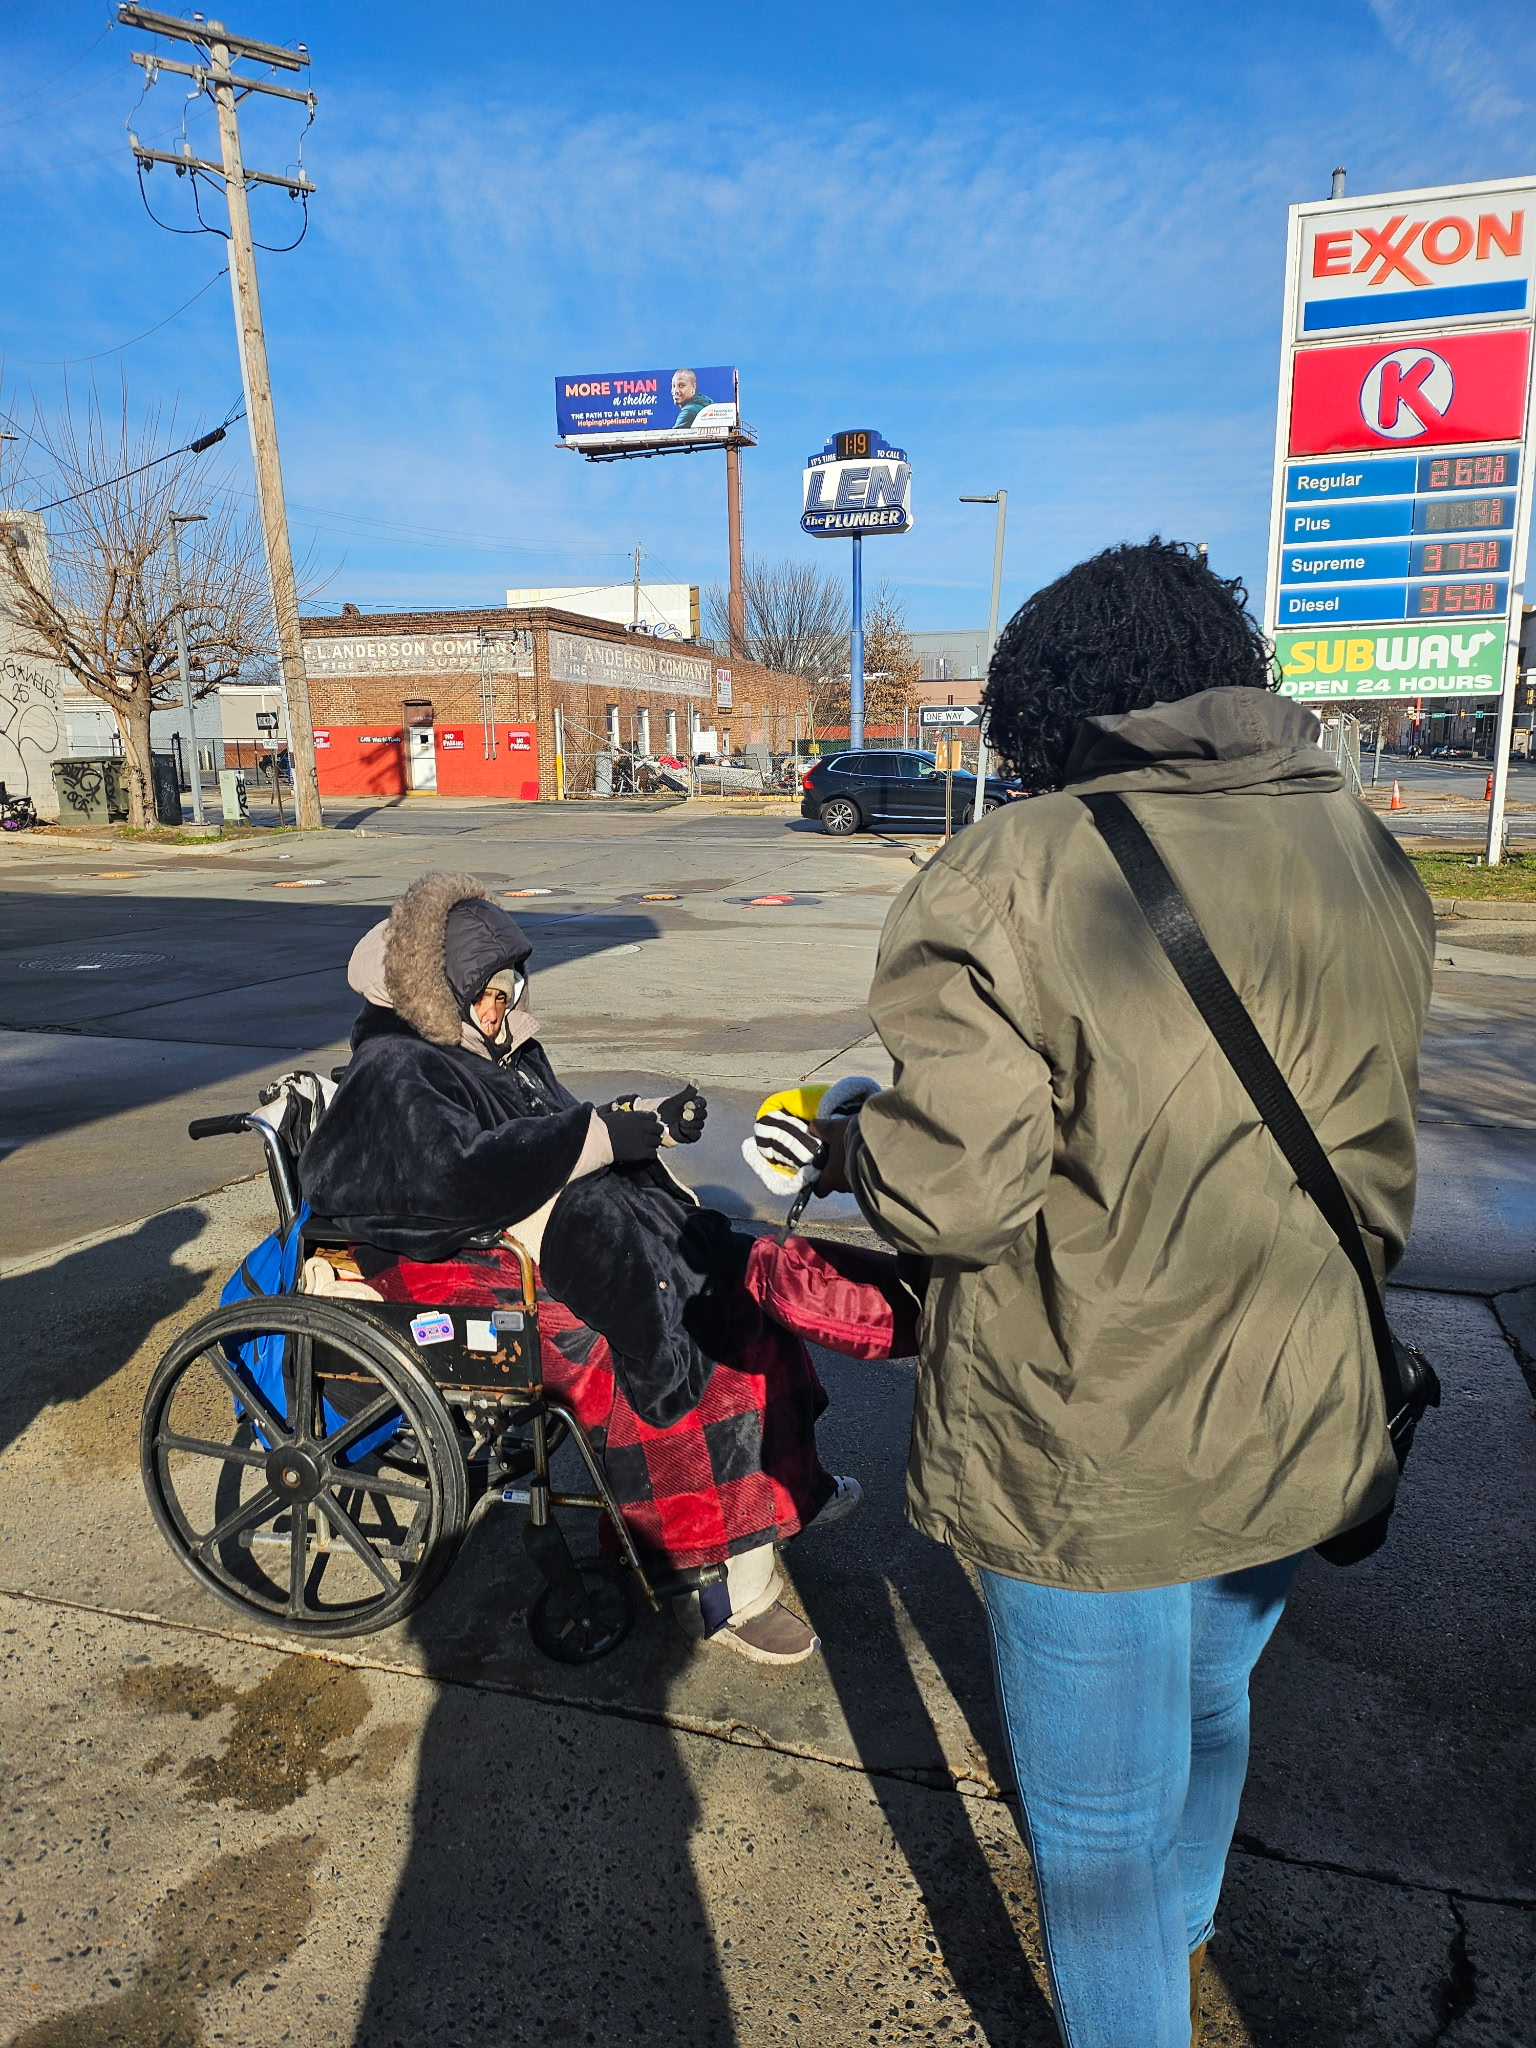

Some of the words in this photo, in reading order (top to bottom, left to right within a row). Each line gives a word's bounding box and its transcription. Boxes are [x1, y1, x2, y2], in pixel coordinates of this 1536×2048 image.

[1312, 209, 1526, 286] EXXON
[565, 381, 611, 397] MORE
[614, 379, 657, 394] THAN
[612, 396, 621, 406] a
[623, 392, 657, 406] shelter.
[577, 417, 648, 427] HelpingUpMission.org
[844, 433, 867, 455] 1:19
[810, 457, 822, 467] IT'S
[877, 449, 885, 458] TO
[886, 450, 900, 460] CALL
[805, 463, 910, 511] LEN
[1297, 472, 1363, 492] Regular
[805, 515, 824, 526] The
[824, 510, 900, 529] PLUMBER
[1294, 516, 1331, 532] Plus
[1291, 557, 1366, 575] Supreme
[1289, 597, 1340, 613] Diesel
[583, 644, 656, 673] ANDERSON
[660, 657, 709, 681] COMPANY
[1282, 629, 1496, 678] SUBWAY
[322, 661, 355, 670] FIRE
[563, 661, 588, 676] FIRE
[1280, 679, 1349, 697] OPEN
[1356, 678, 1391, 693] 24
[1399, 674, 1493, 692] HOURS
[926, 712, 943, 721] ONE
[945, 712, 963, 720] WAY
